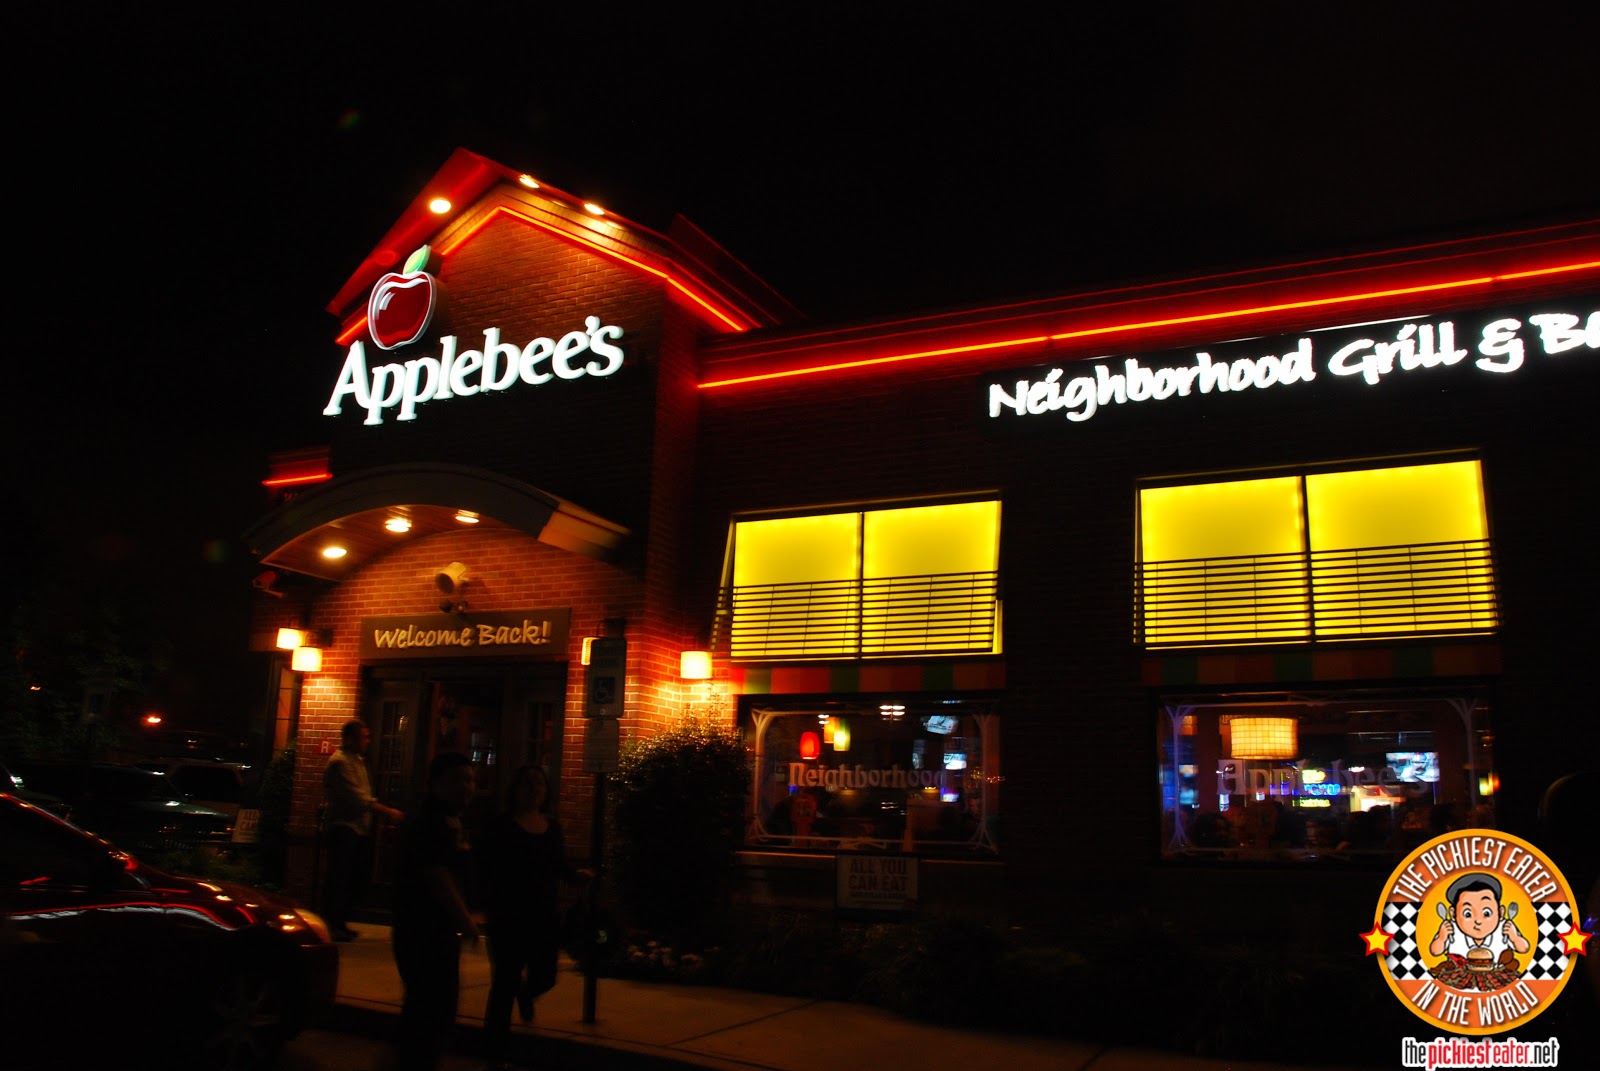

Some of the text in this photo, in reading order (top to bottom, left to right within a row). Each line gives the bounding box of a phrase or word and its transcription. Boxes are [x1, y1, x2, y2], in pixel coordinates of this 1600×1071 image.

[322, 315, 625, 426] Applebee's
[988, 337, 1316, 422] Neighborhood
[1328, 321, 1468, 385] Grill
[1475, 318, 1525, 373] &
[374, 619, 552, 649] Welcome Back!
[320, 740, 330, 754] R
[1216, 758, 1430, 803] Applbees
[849, 859, 907, 874] ALL YOU
[849, 874, 907, 891] CAN EAT
